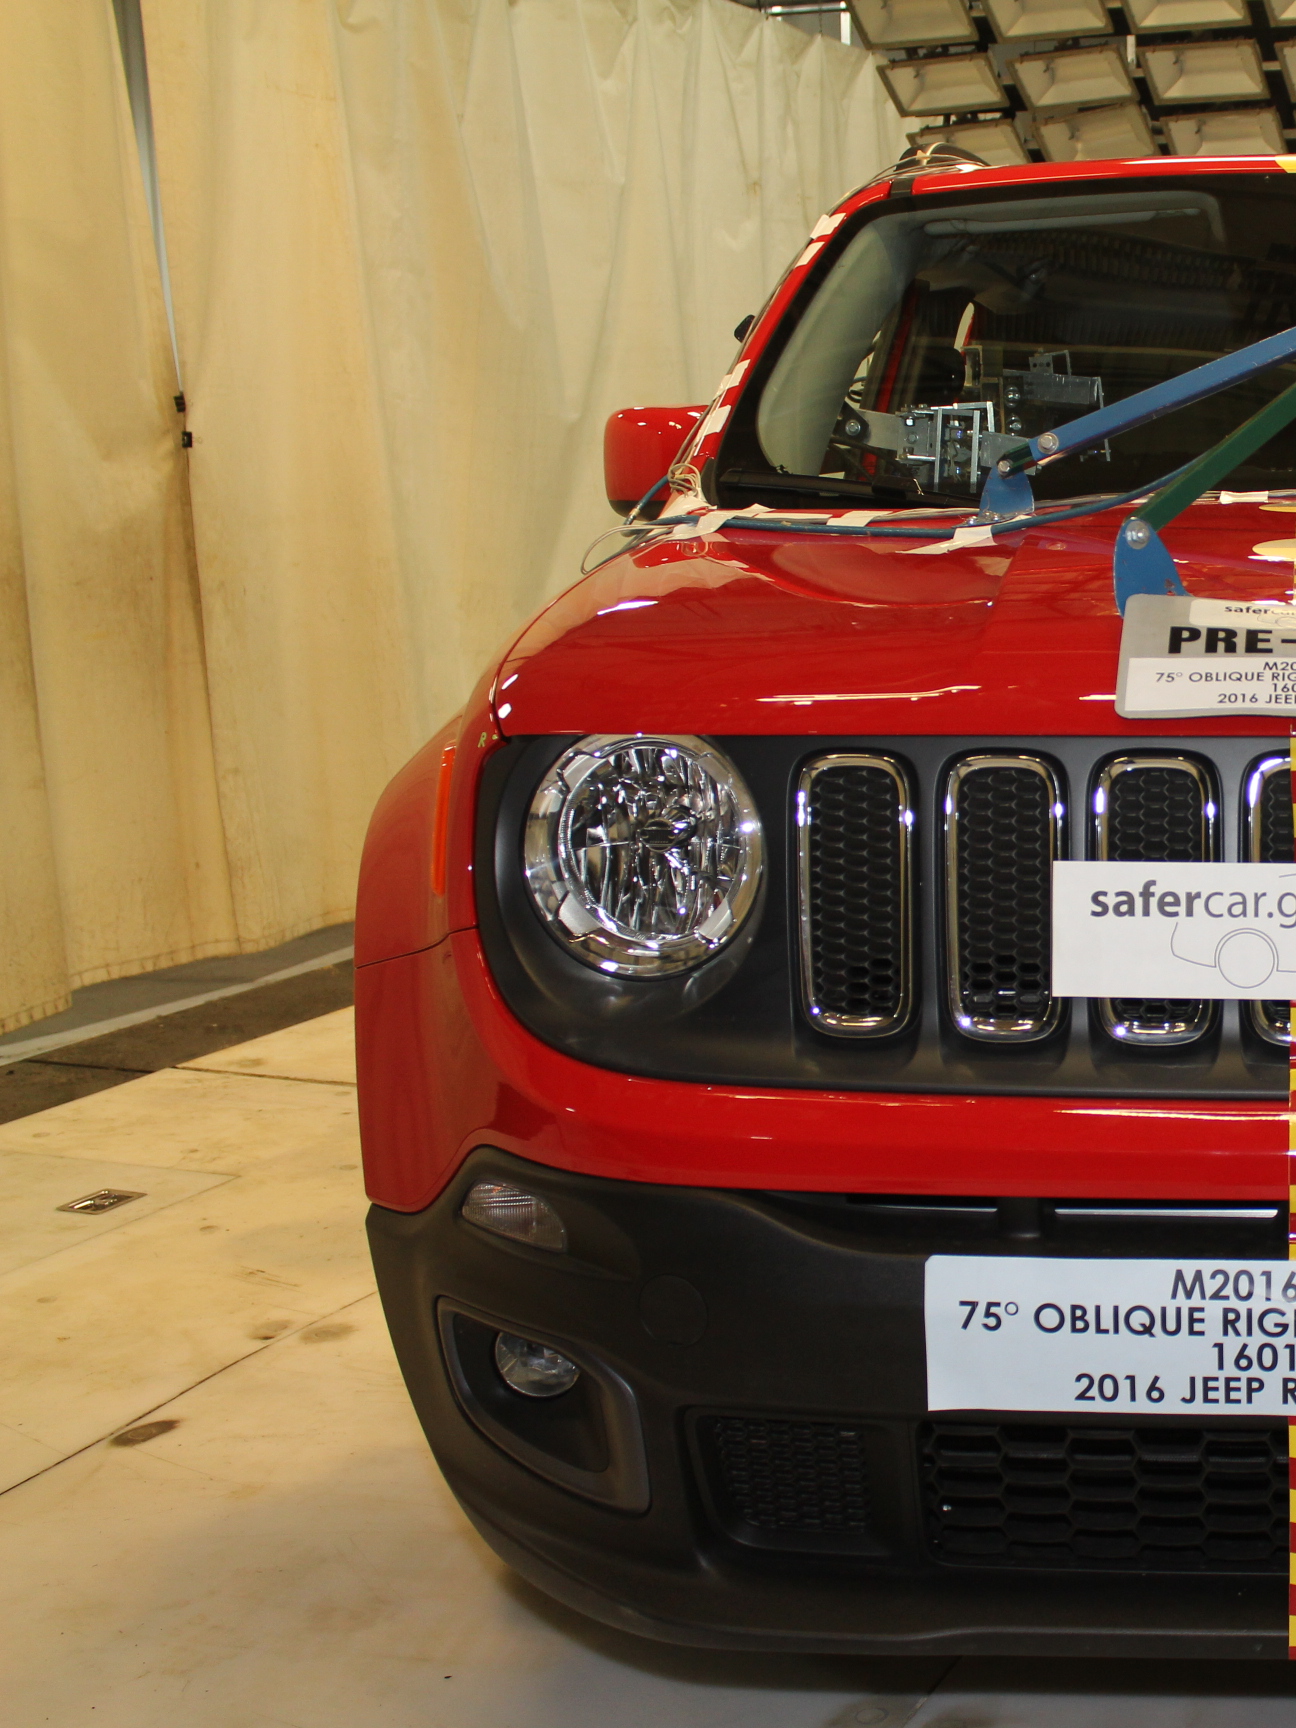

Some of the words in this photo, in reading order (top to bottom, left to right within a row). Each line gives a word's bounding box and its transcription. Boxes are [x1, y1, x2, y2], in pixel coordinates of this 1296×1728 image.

[1155, 672, 1183, 683] 75°
[1188, 671, 1265, 683] OBLIQUE
[1217, 693, 1259, 704] 2016
[958, 1300, 1019, 1331] 75°
[1033, 1303, 1206, 1338] OBLIQUE
[1074, 1373, 1165, 1403] 2016
[1180, 1376, 1265, 1404] JEEP
